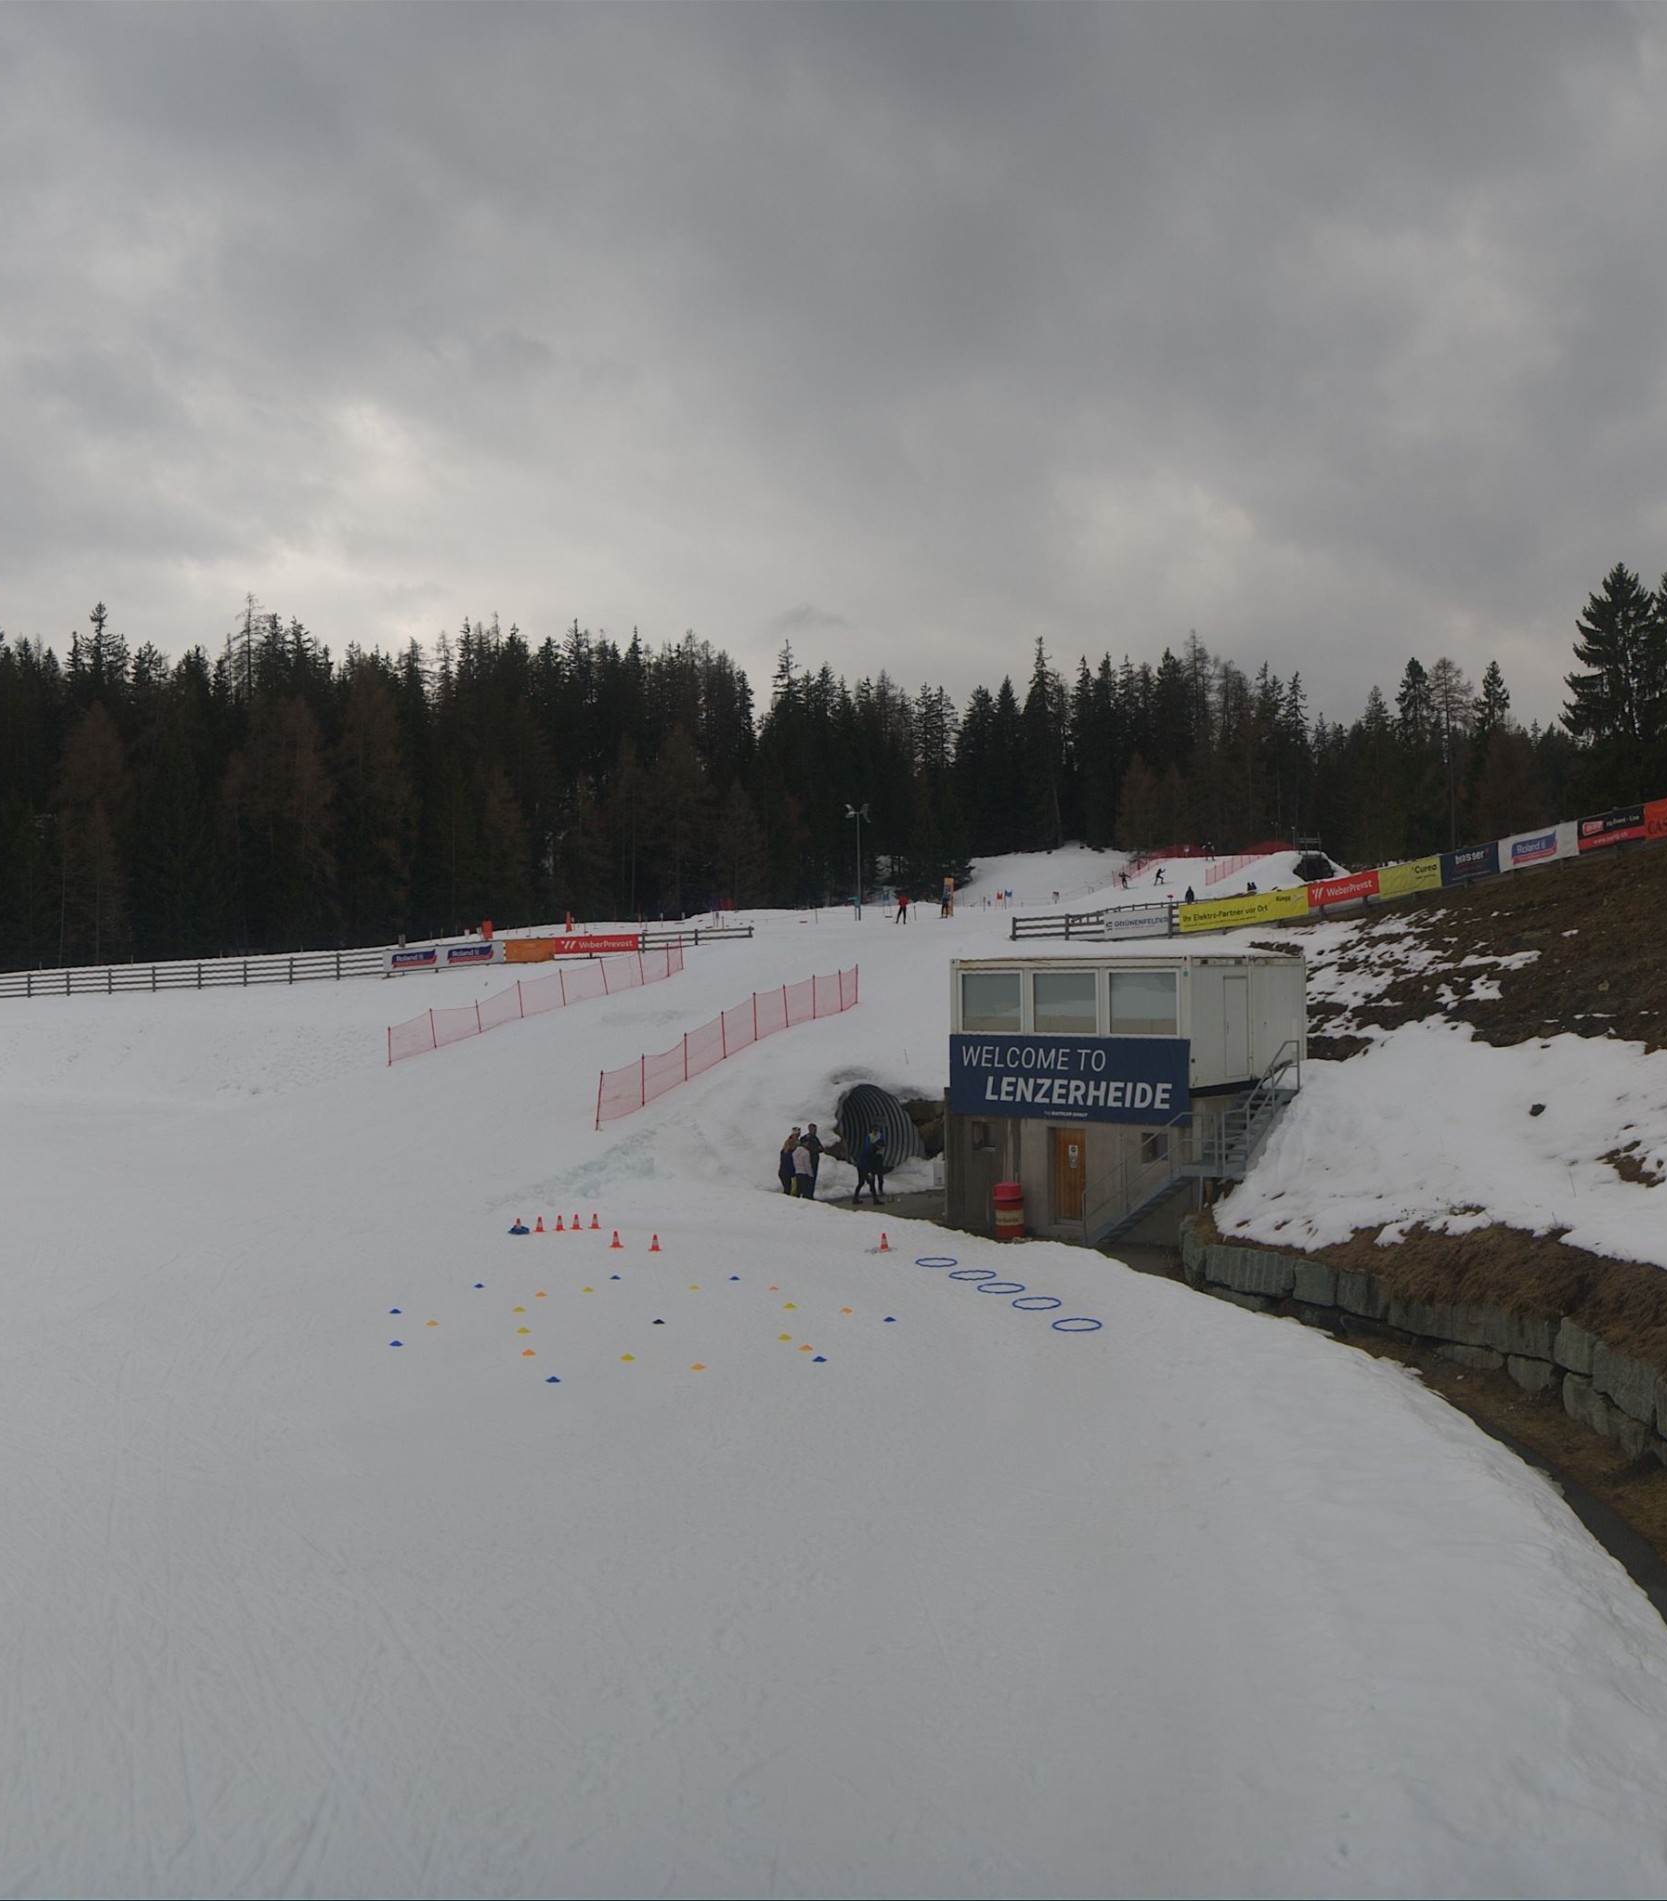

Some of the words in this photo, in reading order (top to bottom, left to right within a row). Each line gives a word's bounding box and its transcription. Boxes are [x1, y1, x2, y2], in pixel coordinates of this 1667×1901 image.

[1516, 842, 1541, 855] Roland
[961, 1045, 1071, 1071] WELCOME
[1077, 1049, 1107, 1072] TO
[984, 1075, 1173, 1110] LENZERHEIDE
